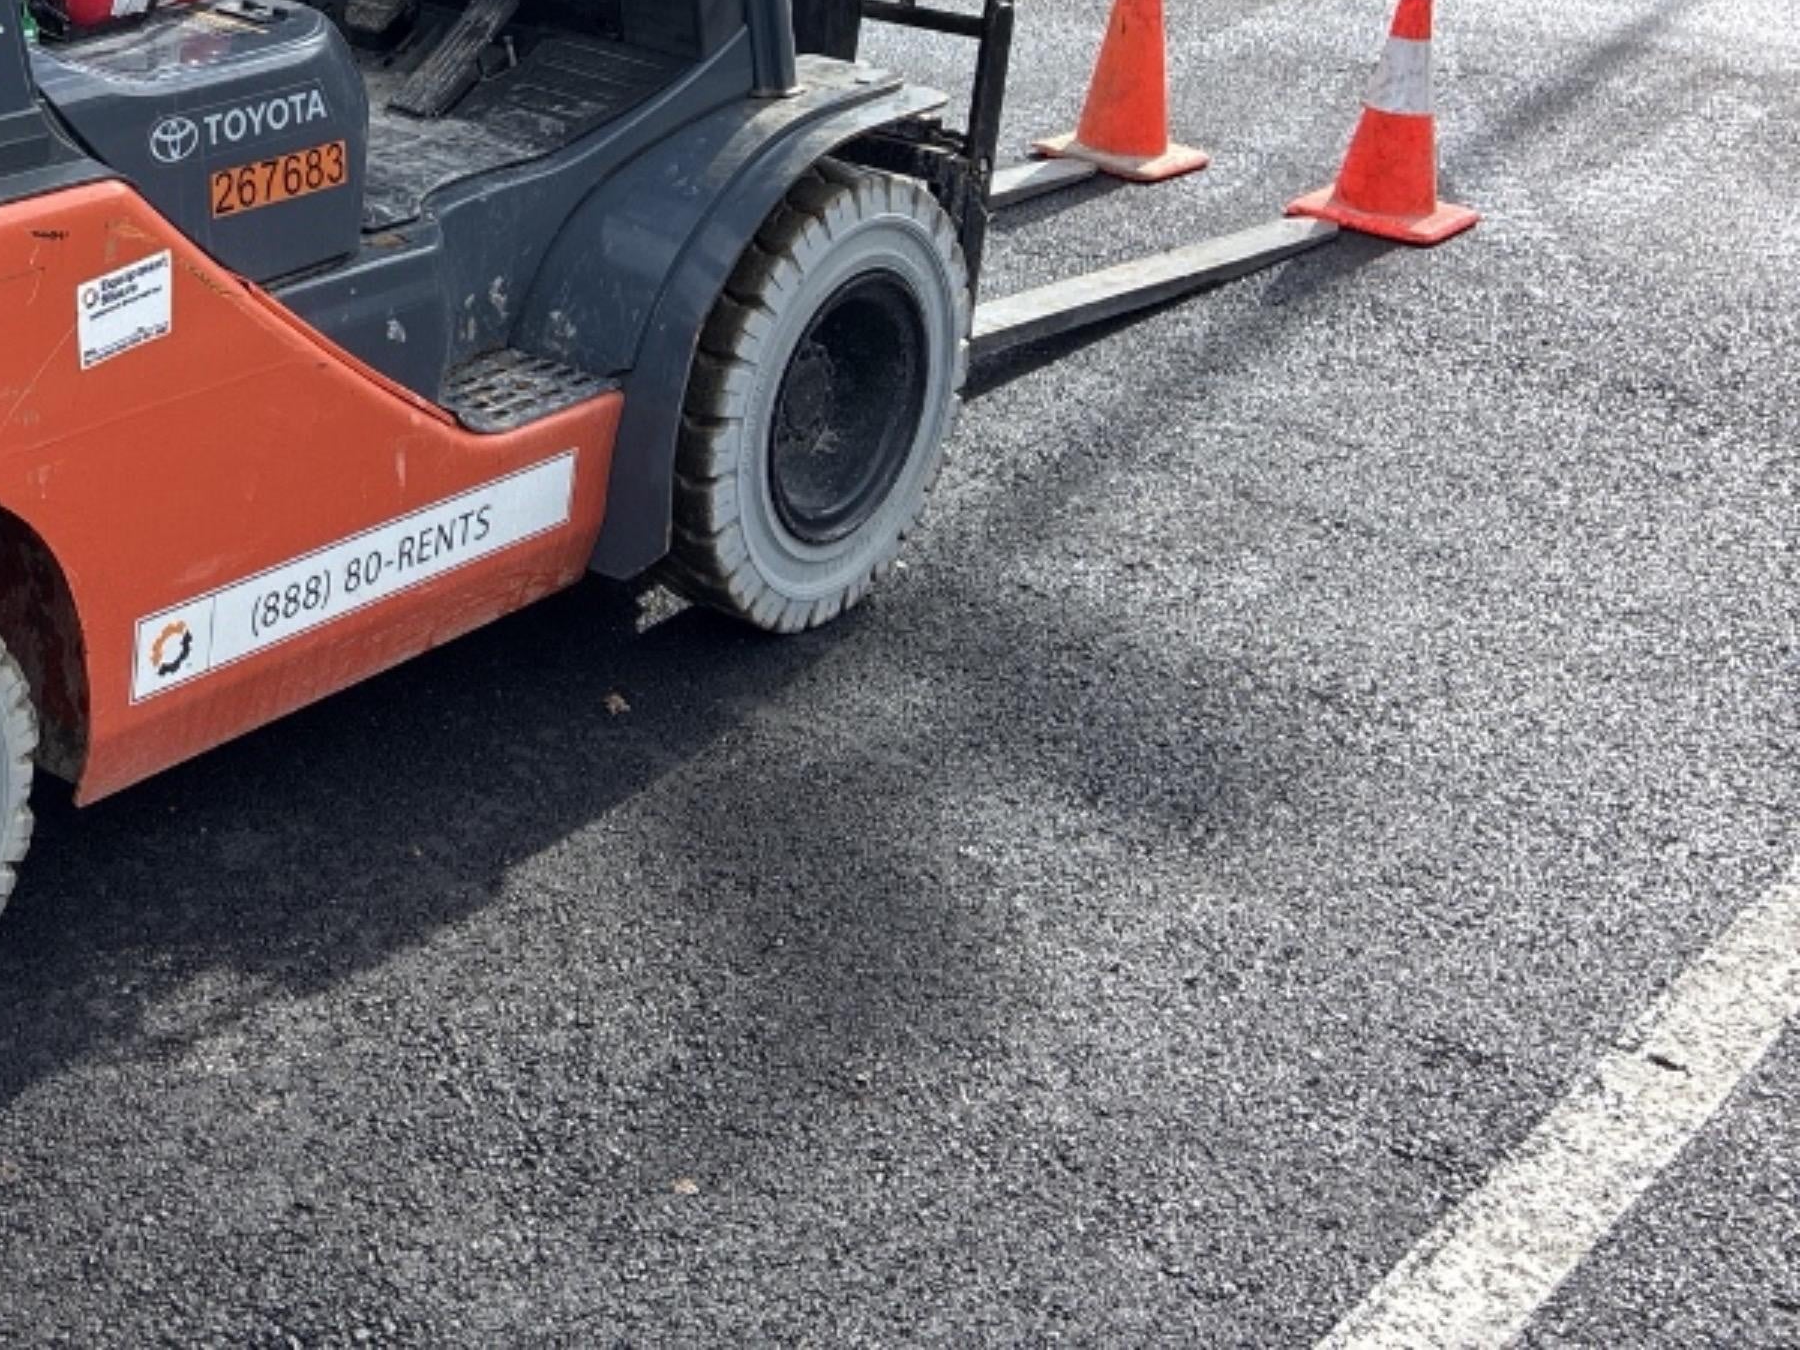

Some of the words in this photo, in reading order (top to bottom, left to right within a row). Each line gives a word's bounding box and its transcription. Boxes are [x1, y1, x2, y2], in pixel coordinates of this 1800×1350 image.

[203, 89, 328, 146] TOYOTA
[215, 143, 344, 214] 267683
[251, 569, 332, 637] (888)
[344, 503, 493, 593] 80-RENTS
